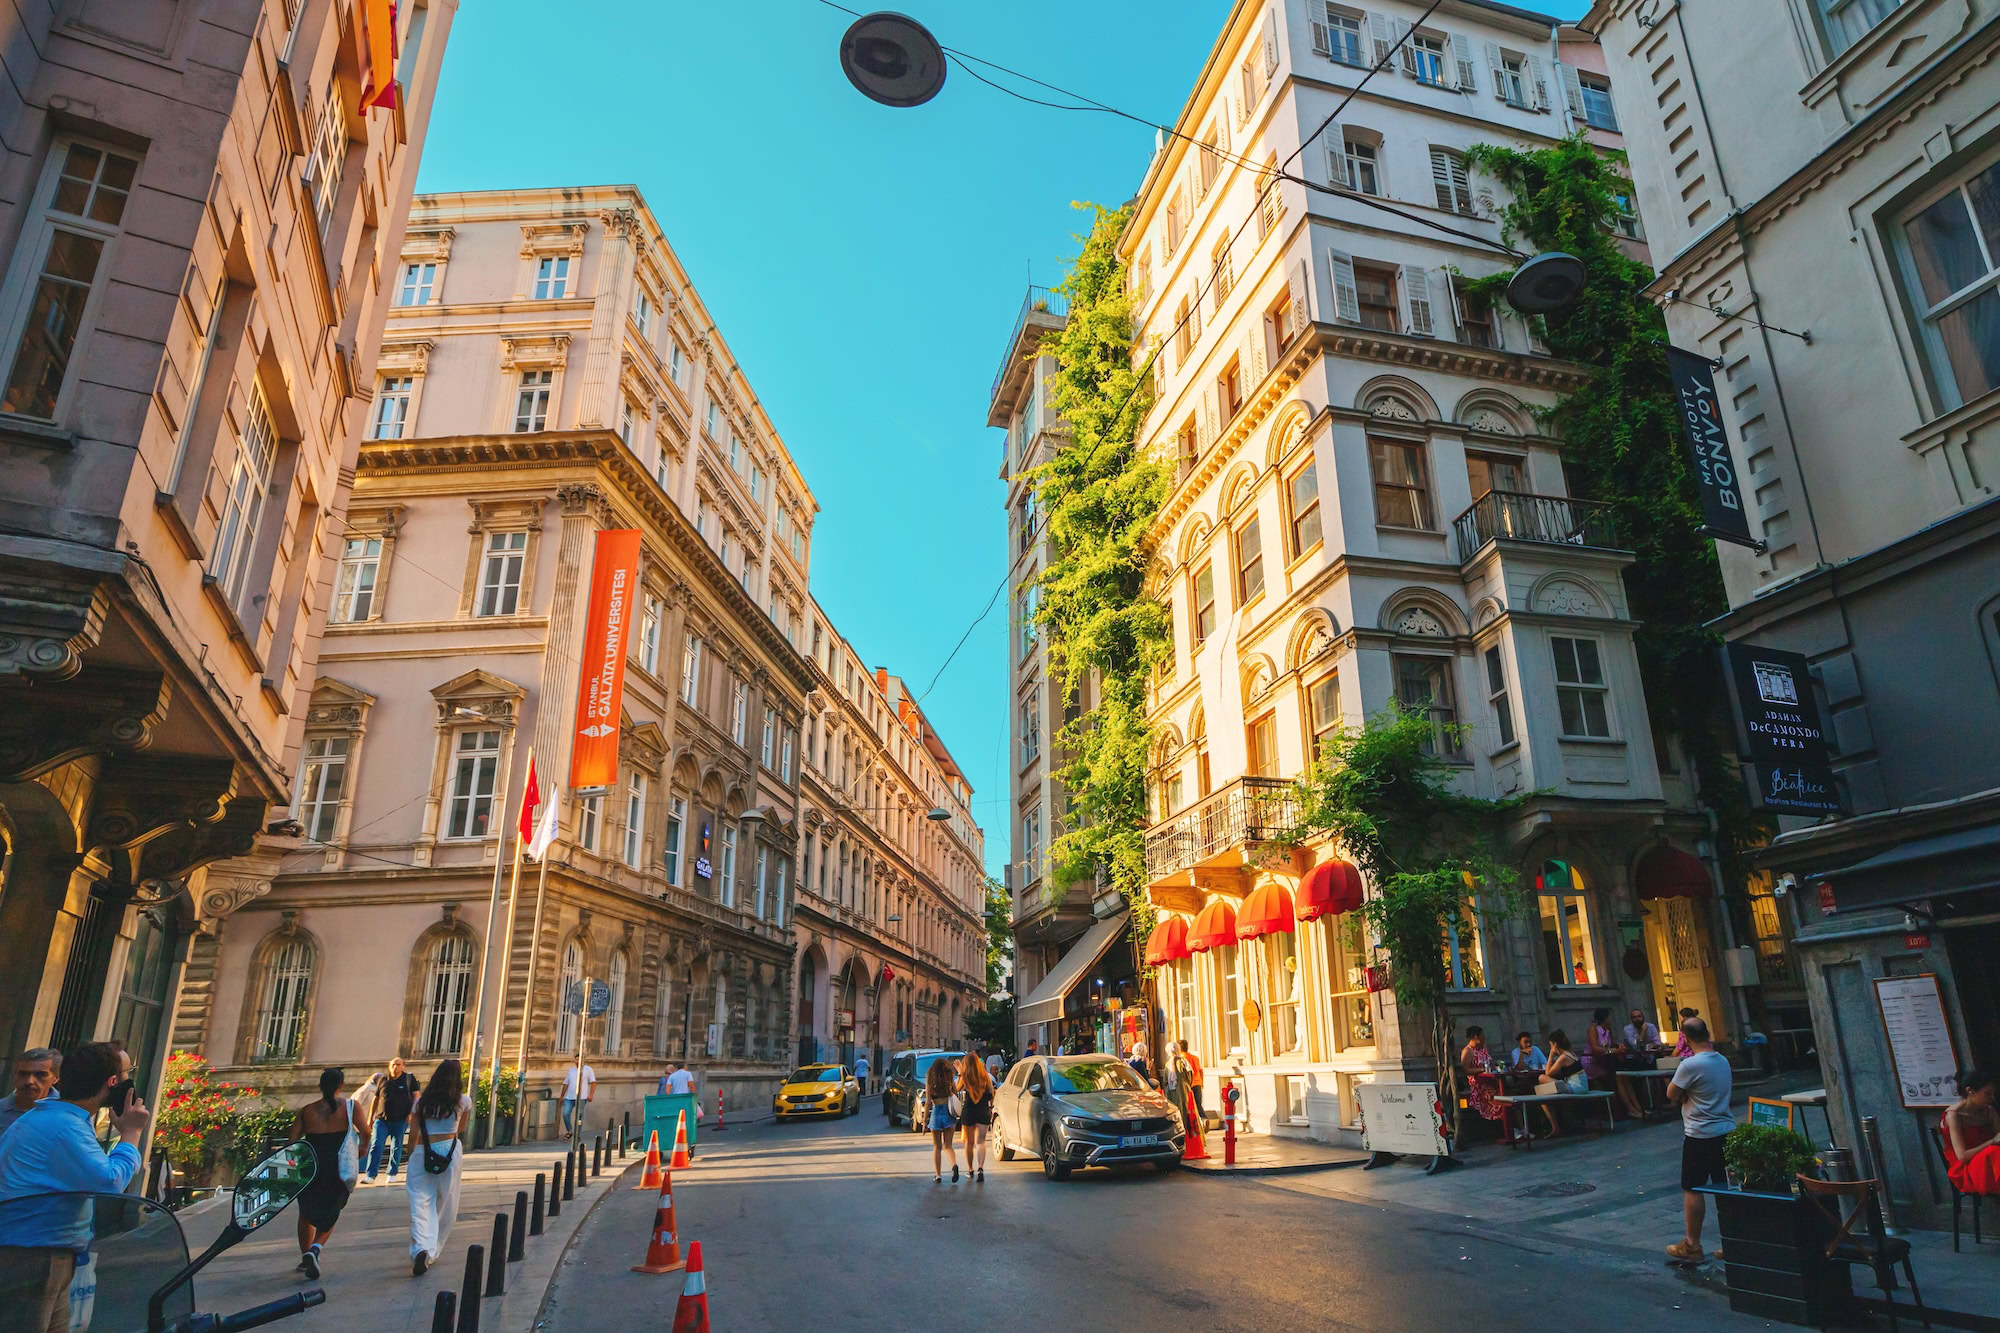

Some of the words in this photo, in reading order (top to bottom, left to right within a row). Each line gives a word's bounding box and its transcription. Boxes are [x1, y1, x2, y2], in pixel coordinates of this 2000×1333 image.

[1681, 388, 1713, 485] MARRIOTT
[1690, 376, 1739, 510] BONVOY
[598, 660, 616, 717] GALATA
[1765, 711, 1802, 723] ADAHAN
[1749, 721, 1820, 739] DeCAMONDO
[1772, 737, 1805, 749] PERA
[1236, 925, 1257, 936] akery
[1187, 938, 1203, 949] akery
[1380, 1093, 1407, 1104] Welcome
